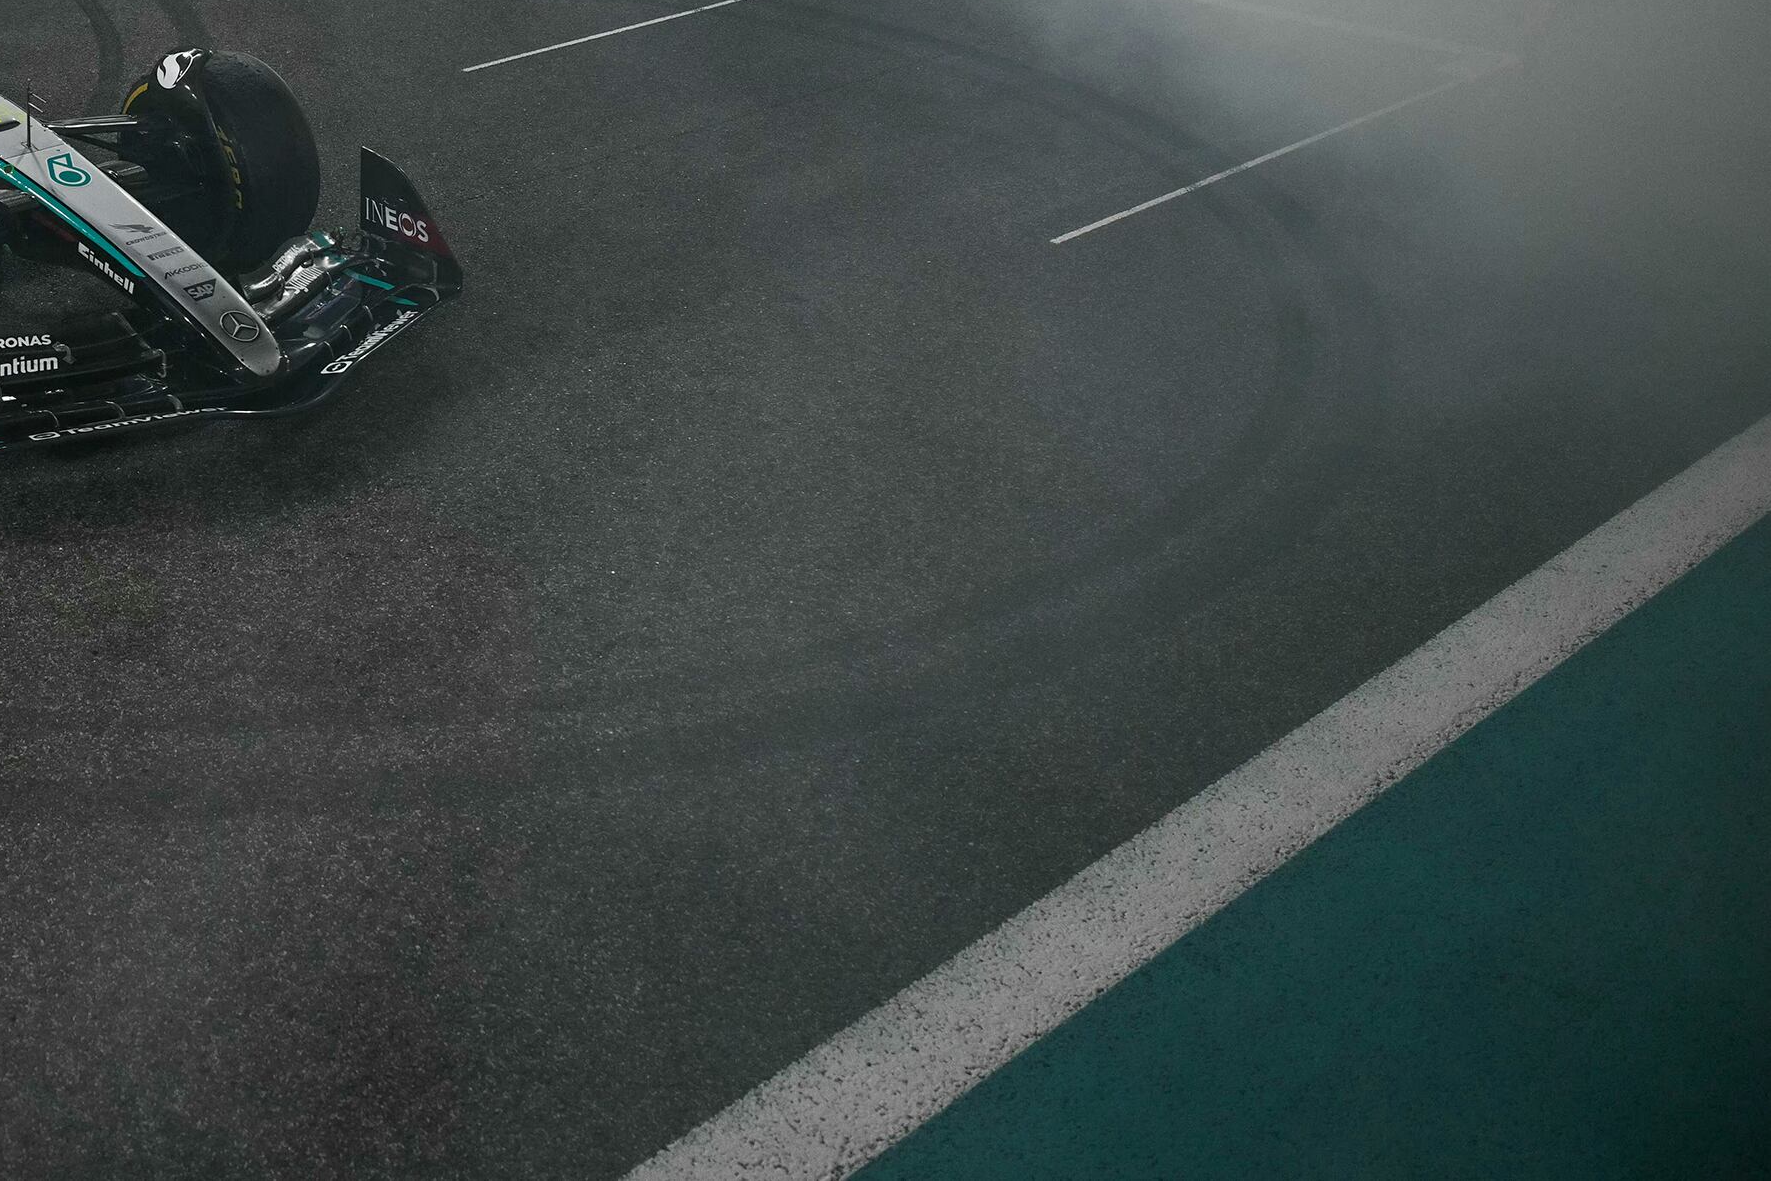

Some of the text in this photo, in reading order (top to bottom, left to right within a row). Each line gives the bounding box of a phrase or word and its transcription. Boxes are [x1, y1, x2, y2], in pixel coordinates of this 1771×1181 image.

[365, 197, 429, 243] INEOS
[78, 241, 135, 295] Einhell
[187, 283, 214, 299] SAP
[60, 406, 228, 436] TeamViewer
